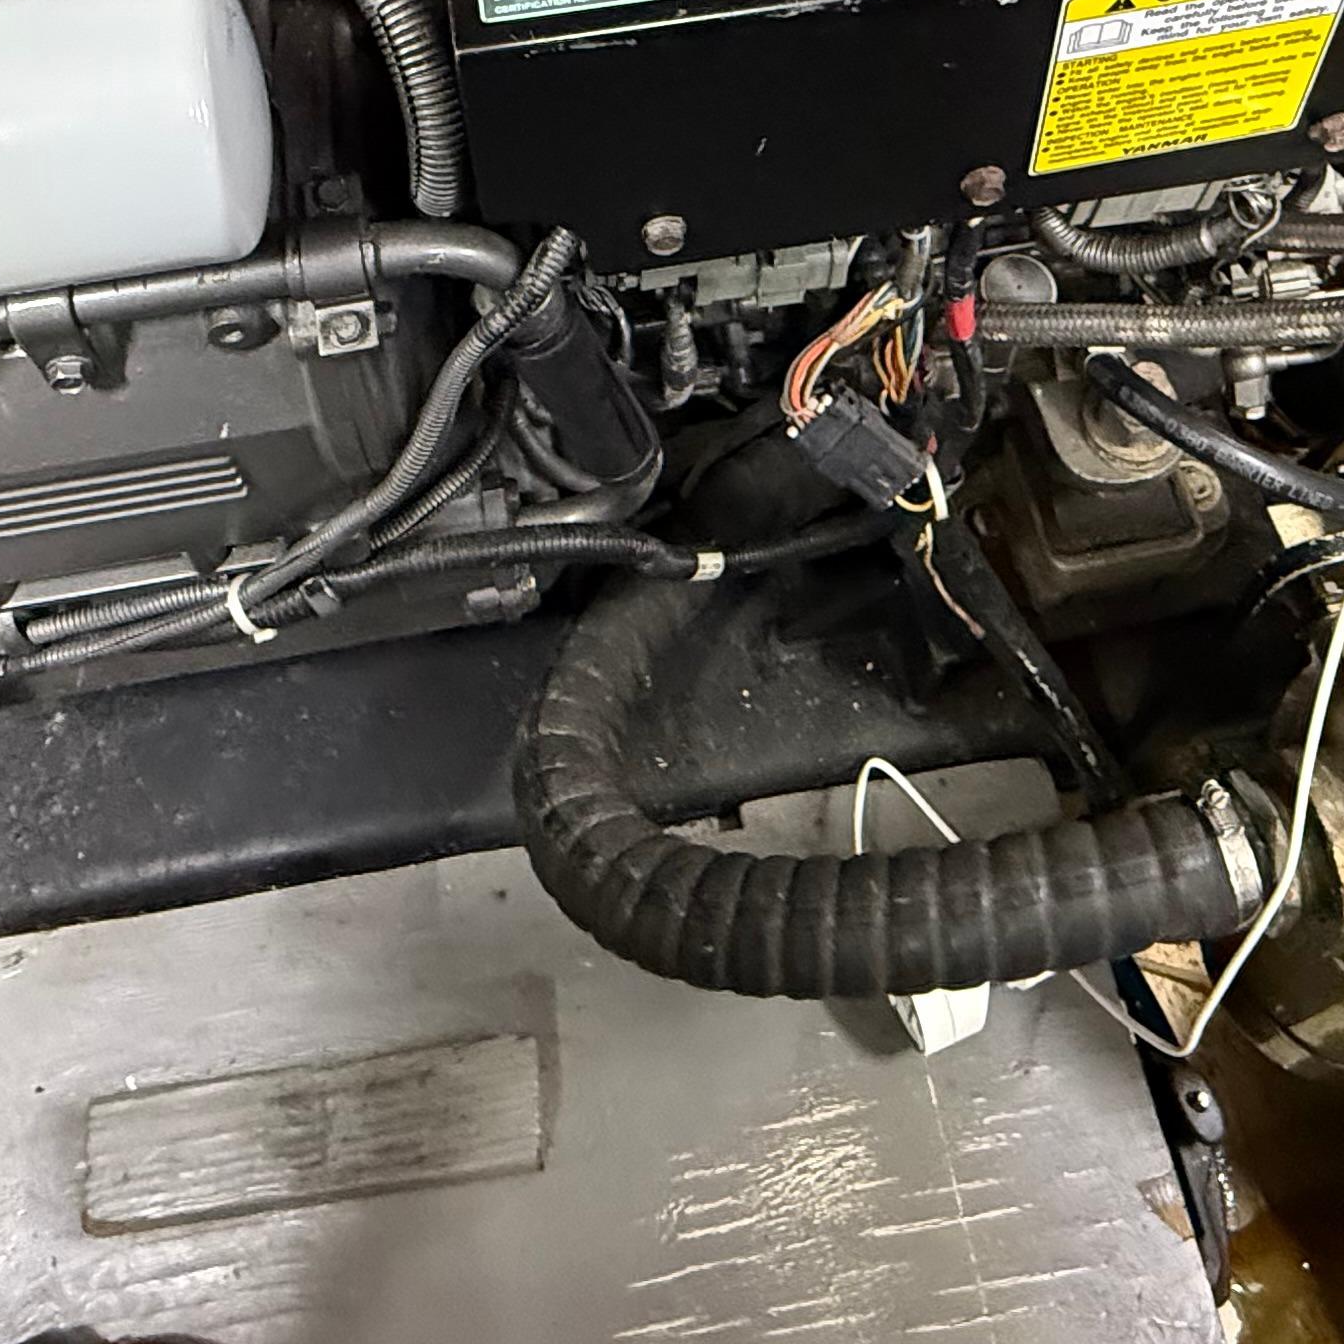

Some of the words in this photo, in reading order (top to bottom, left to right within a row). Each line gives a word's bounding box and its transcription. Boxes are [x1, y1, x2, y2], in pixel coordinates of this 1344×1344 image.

[1144, 5, 1177, 18] Read
[1185, 1, 1205, 10] the
[1164, 8, 1220, 24] carefully
[1141, 24, 1173, 37] Keep
[1180, 19, 1200, 29] the
[1207, 9, 1265, 25] following
[1272, 5, 1284, 13] in
[1157, 29, 1189, 41] mind
[1196, 25, 1212, 34] for
[1221, 19, 1249, 33] your
[1122, 134, 1209, 155] YANMAR
